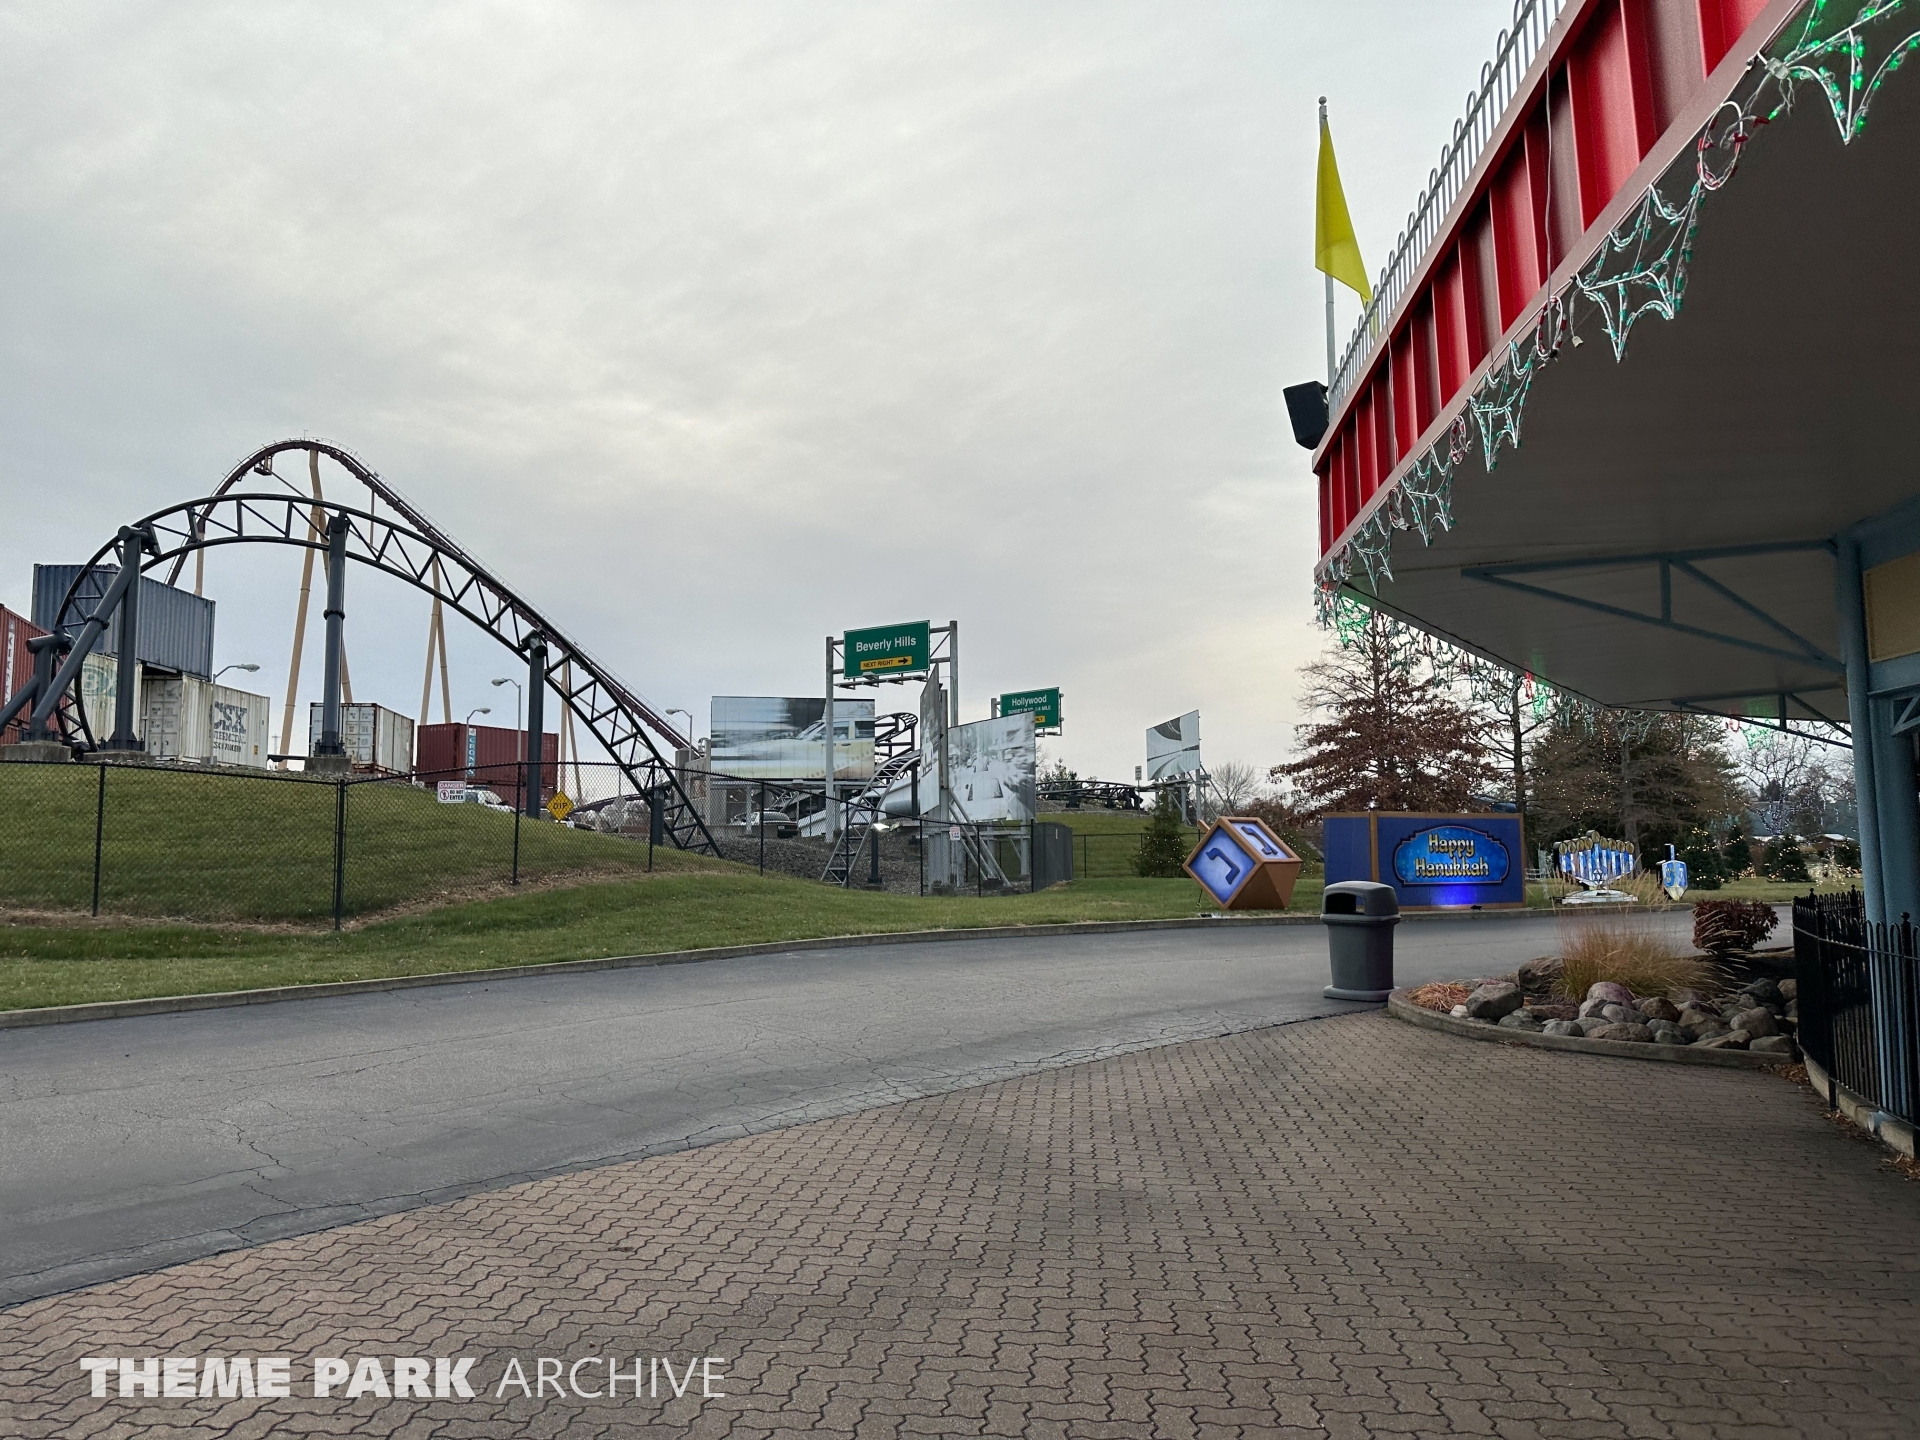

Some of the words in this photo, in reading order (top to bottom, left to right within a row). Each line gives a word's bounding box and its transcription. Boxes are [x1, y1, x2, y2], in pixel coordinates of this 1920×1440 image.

[856, 639, 892, 652] Beverly
[894, 635, 917, 648] Hills
[863, 661, 877, 669] NEXT
[877, 659, 894, 667] RIGHT
[1011, 694, 1047, 707] Hollywood
[553, 802, 568, 810] DIP
[1428, 833, 1475, 858] Happy
[1414, 856, 1489, 877] Hanukkah
